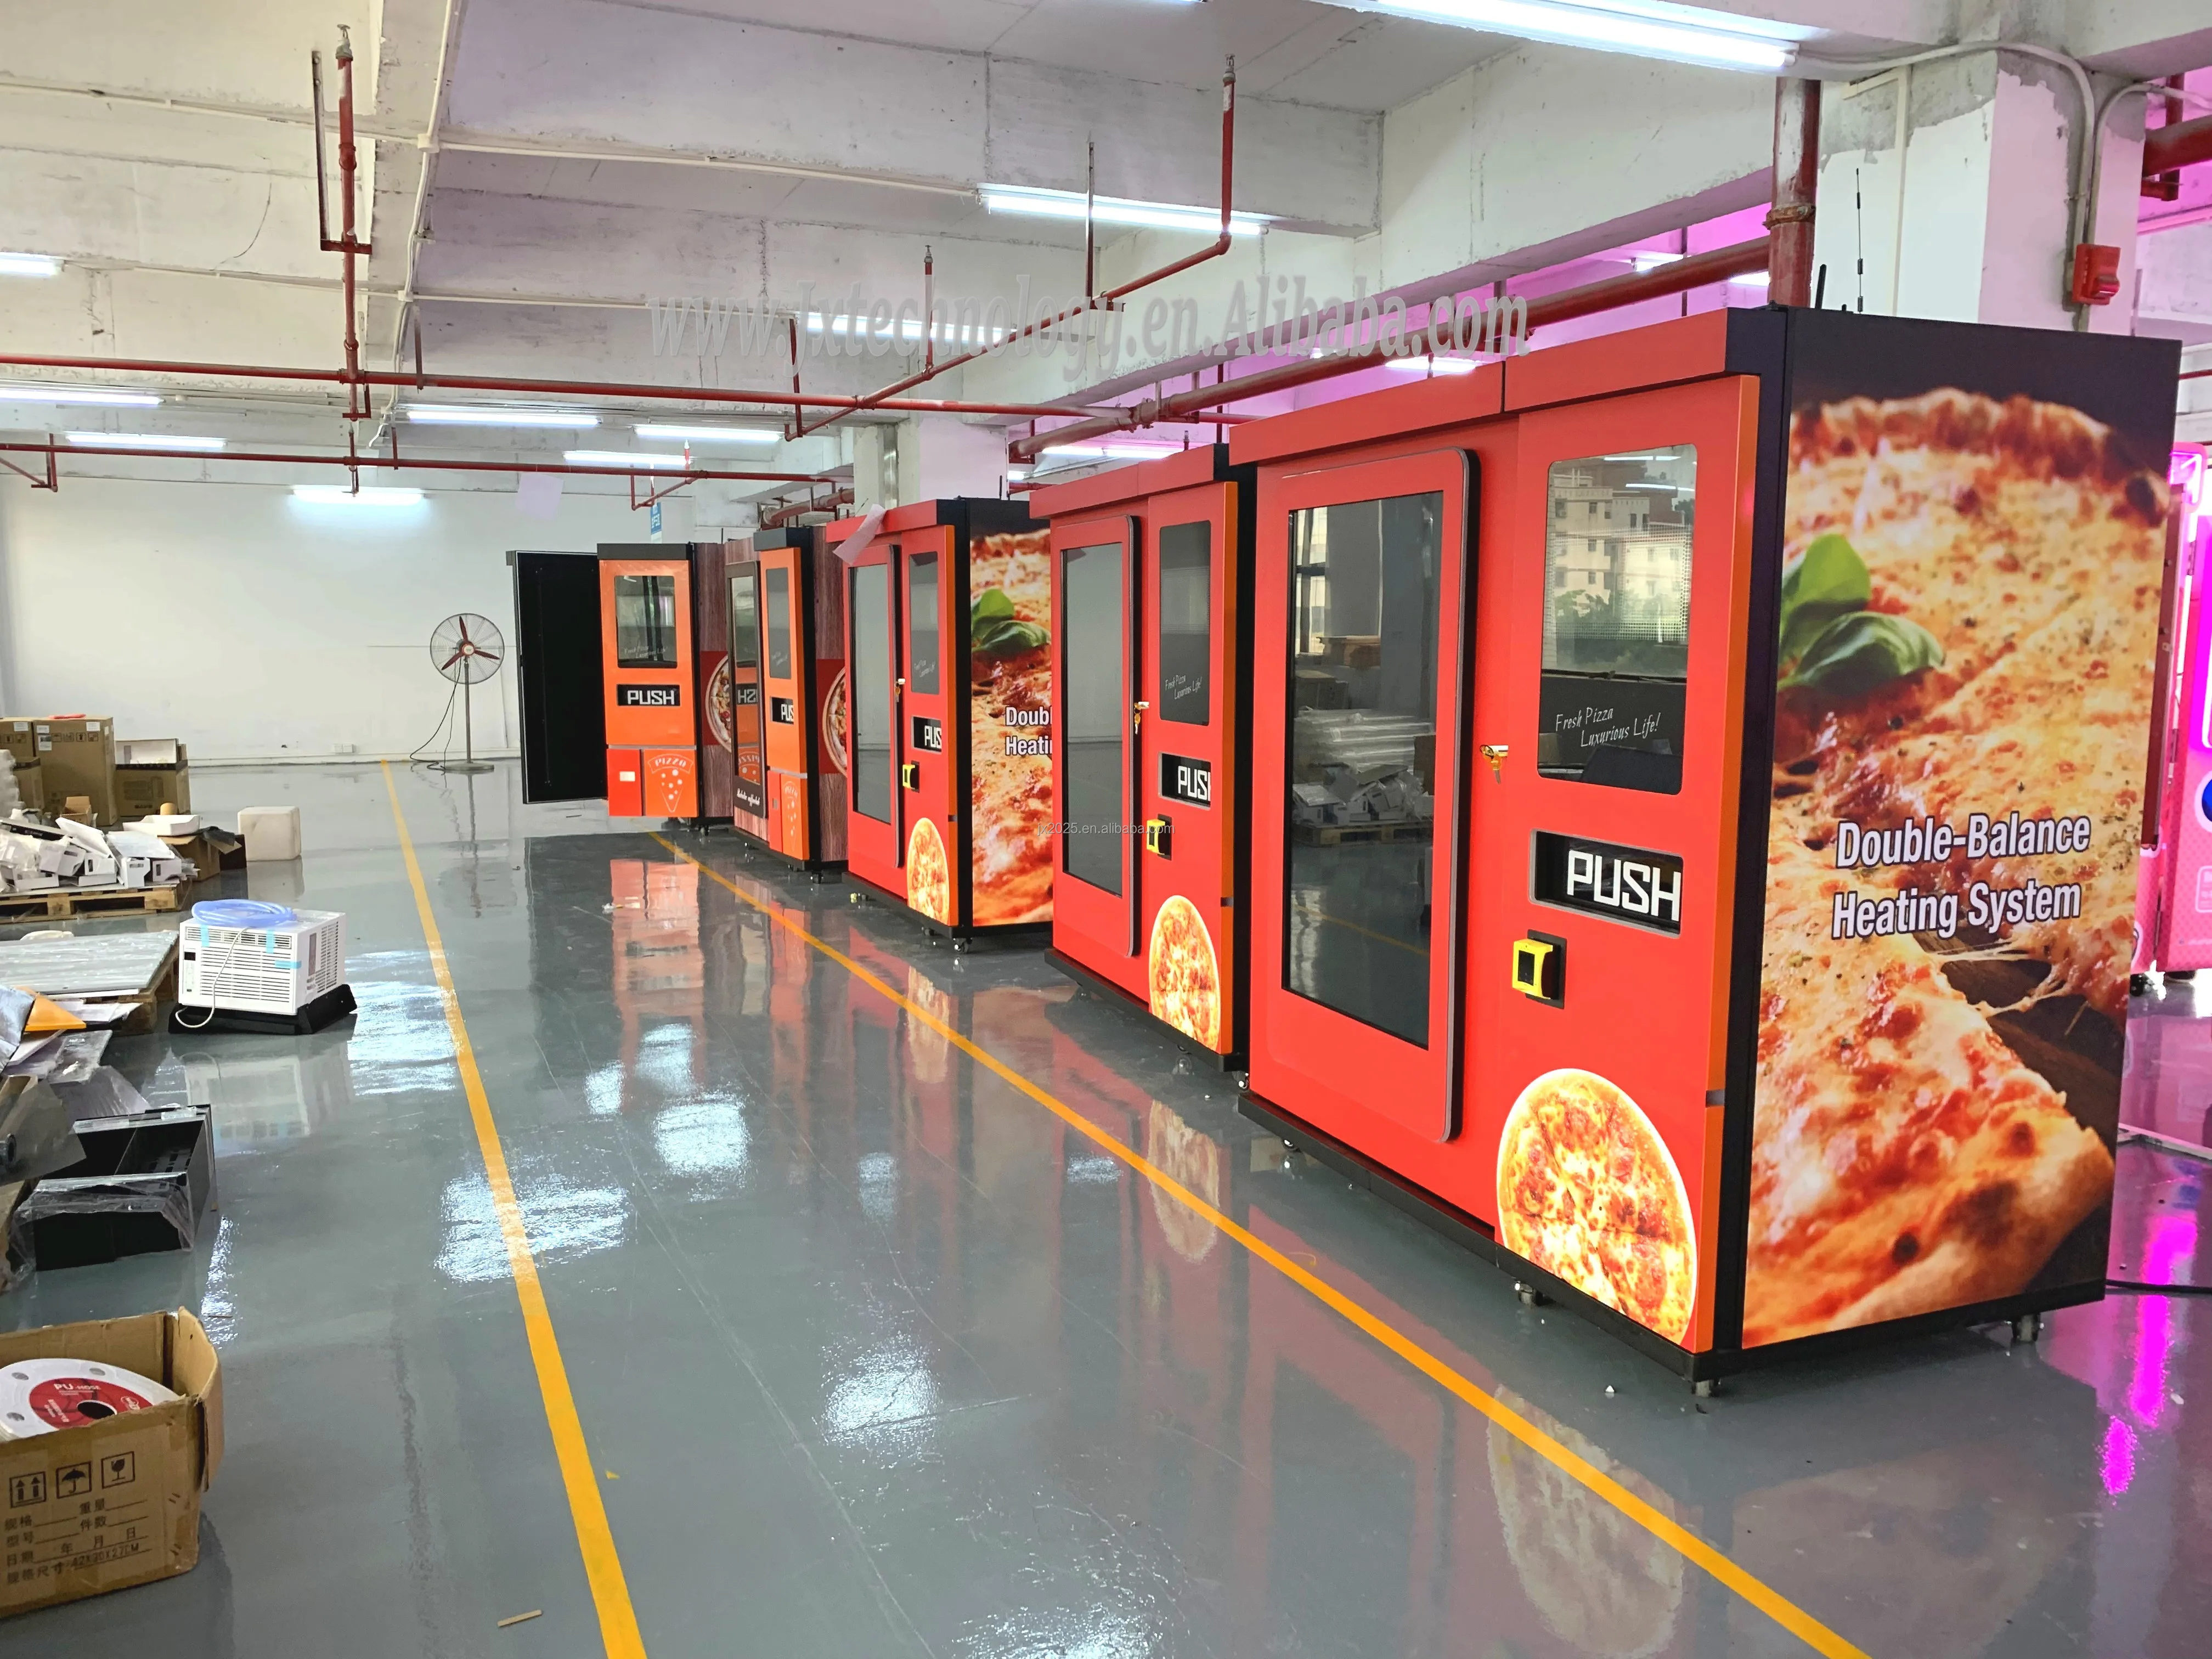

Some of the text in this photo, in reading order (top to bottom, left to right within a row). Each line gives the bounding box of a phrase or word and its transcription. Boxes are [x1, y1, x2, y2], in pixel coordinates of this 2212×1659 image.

[627, 690, 674, 705] PUSH
[1555, 707, 1614, 732] Fresh Pizza
[1581, 713, 1661, 748] Luxurious Life!
[924, 725, 942, 749] PUS
[1836, 811, 2091, 869] Double-Balance
[1567, 849, 1681, 922] PUSH
[1832, 878, 2081, 940] Heating System
[93, 1536, 104, 1548] 月
[126, 1527, 136, 1540] 日
